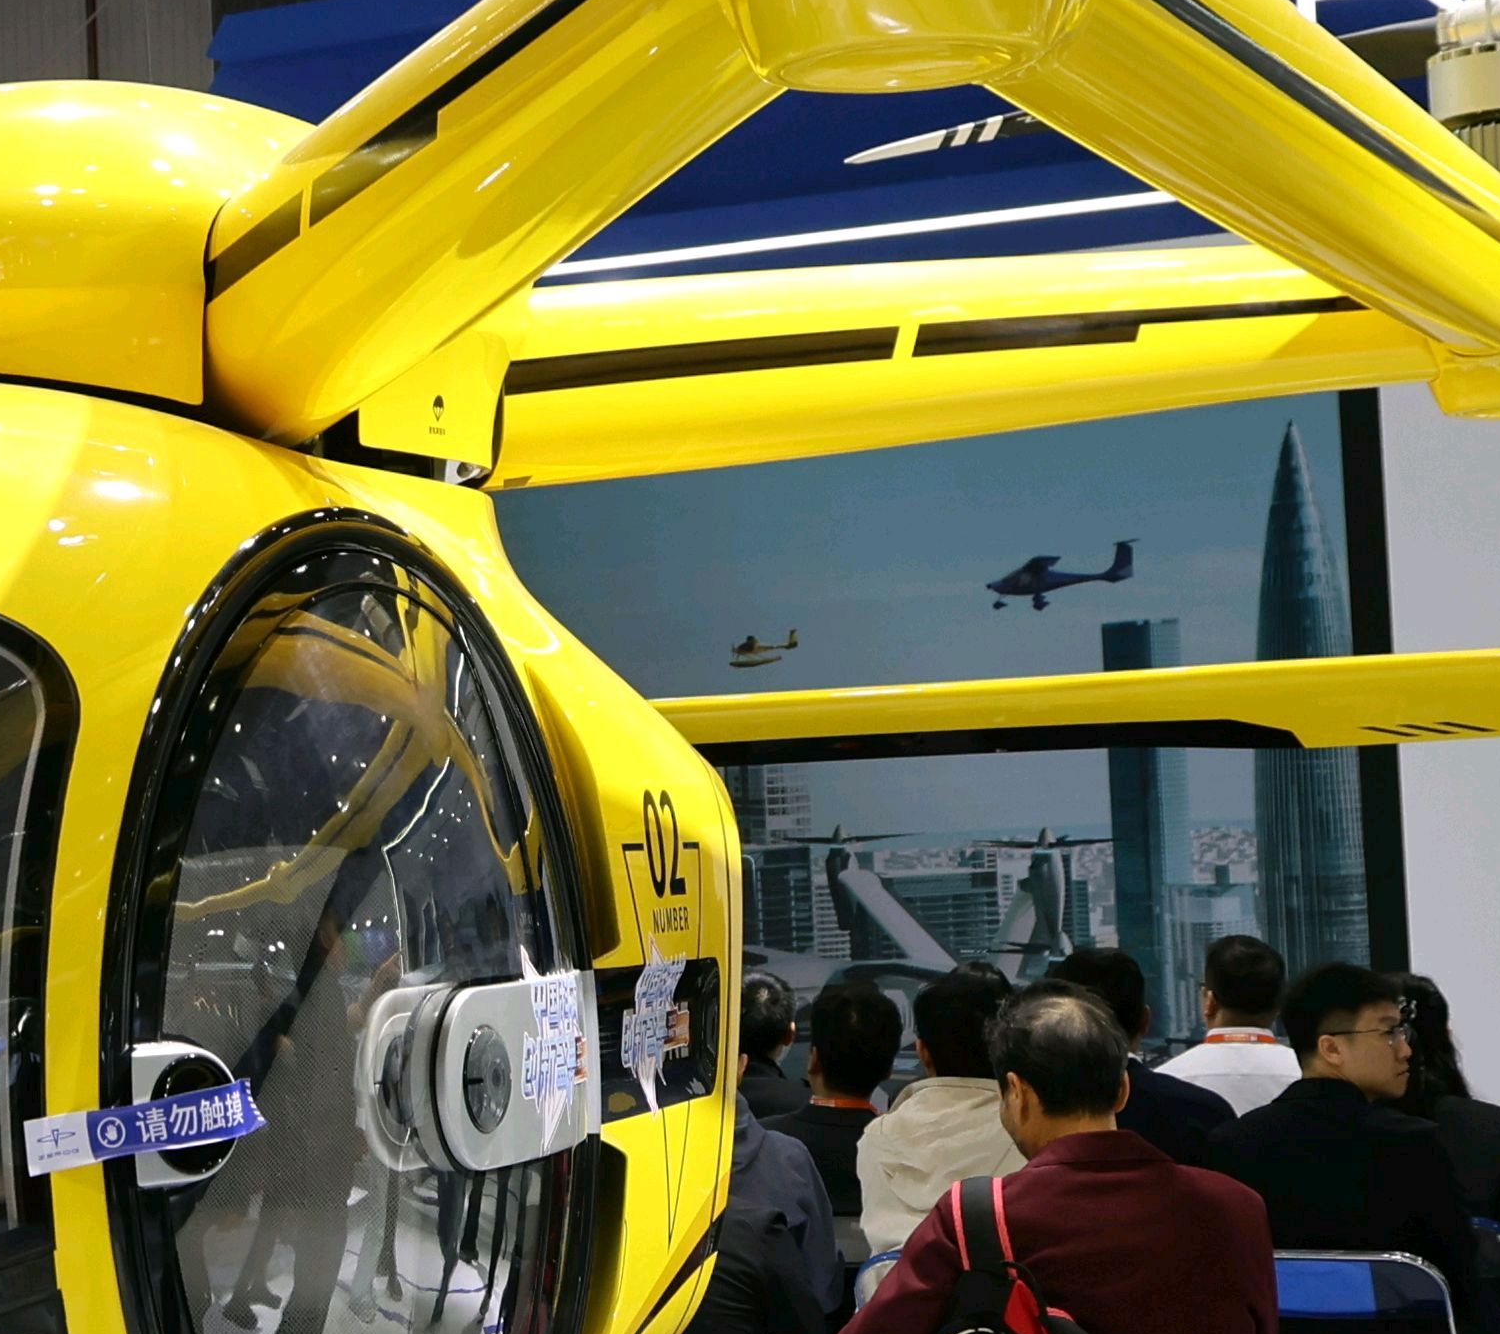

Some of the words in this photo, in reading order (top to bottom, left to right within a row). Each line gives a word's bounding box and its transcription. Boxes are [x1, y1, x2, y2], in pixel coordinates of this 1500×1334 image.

[643, 788, 687, 899] 02
[652, 906, 690, 934] NUMBER
[135, 1090, 245, 1144] 请勿触摸
